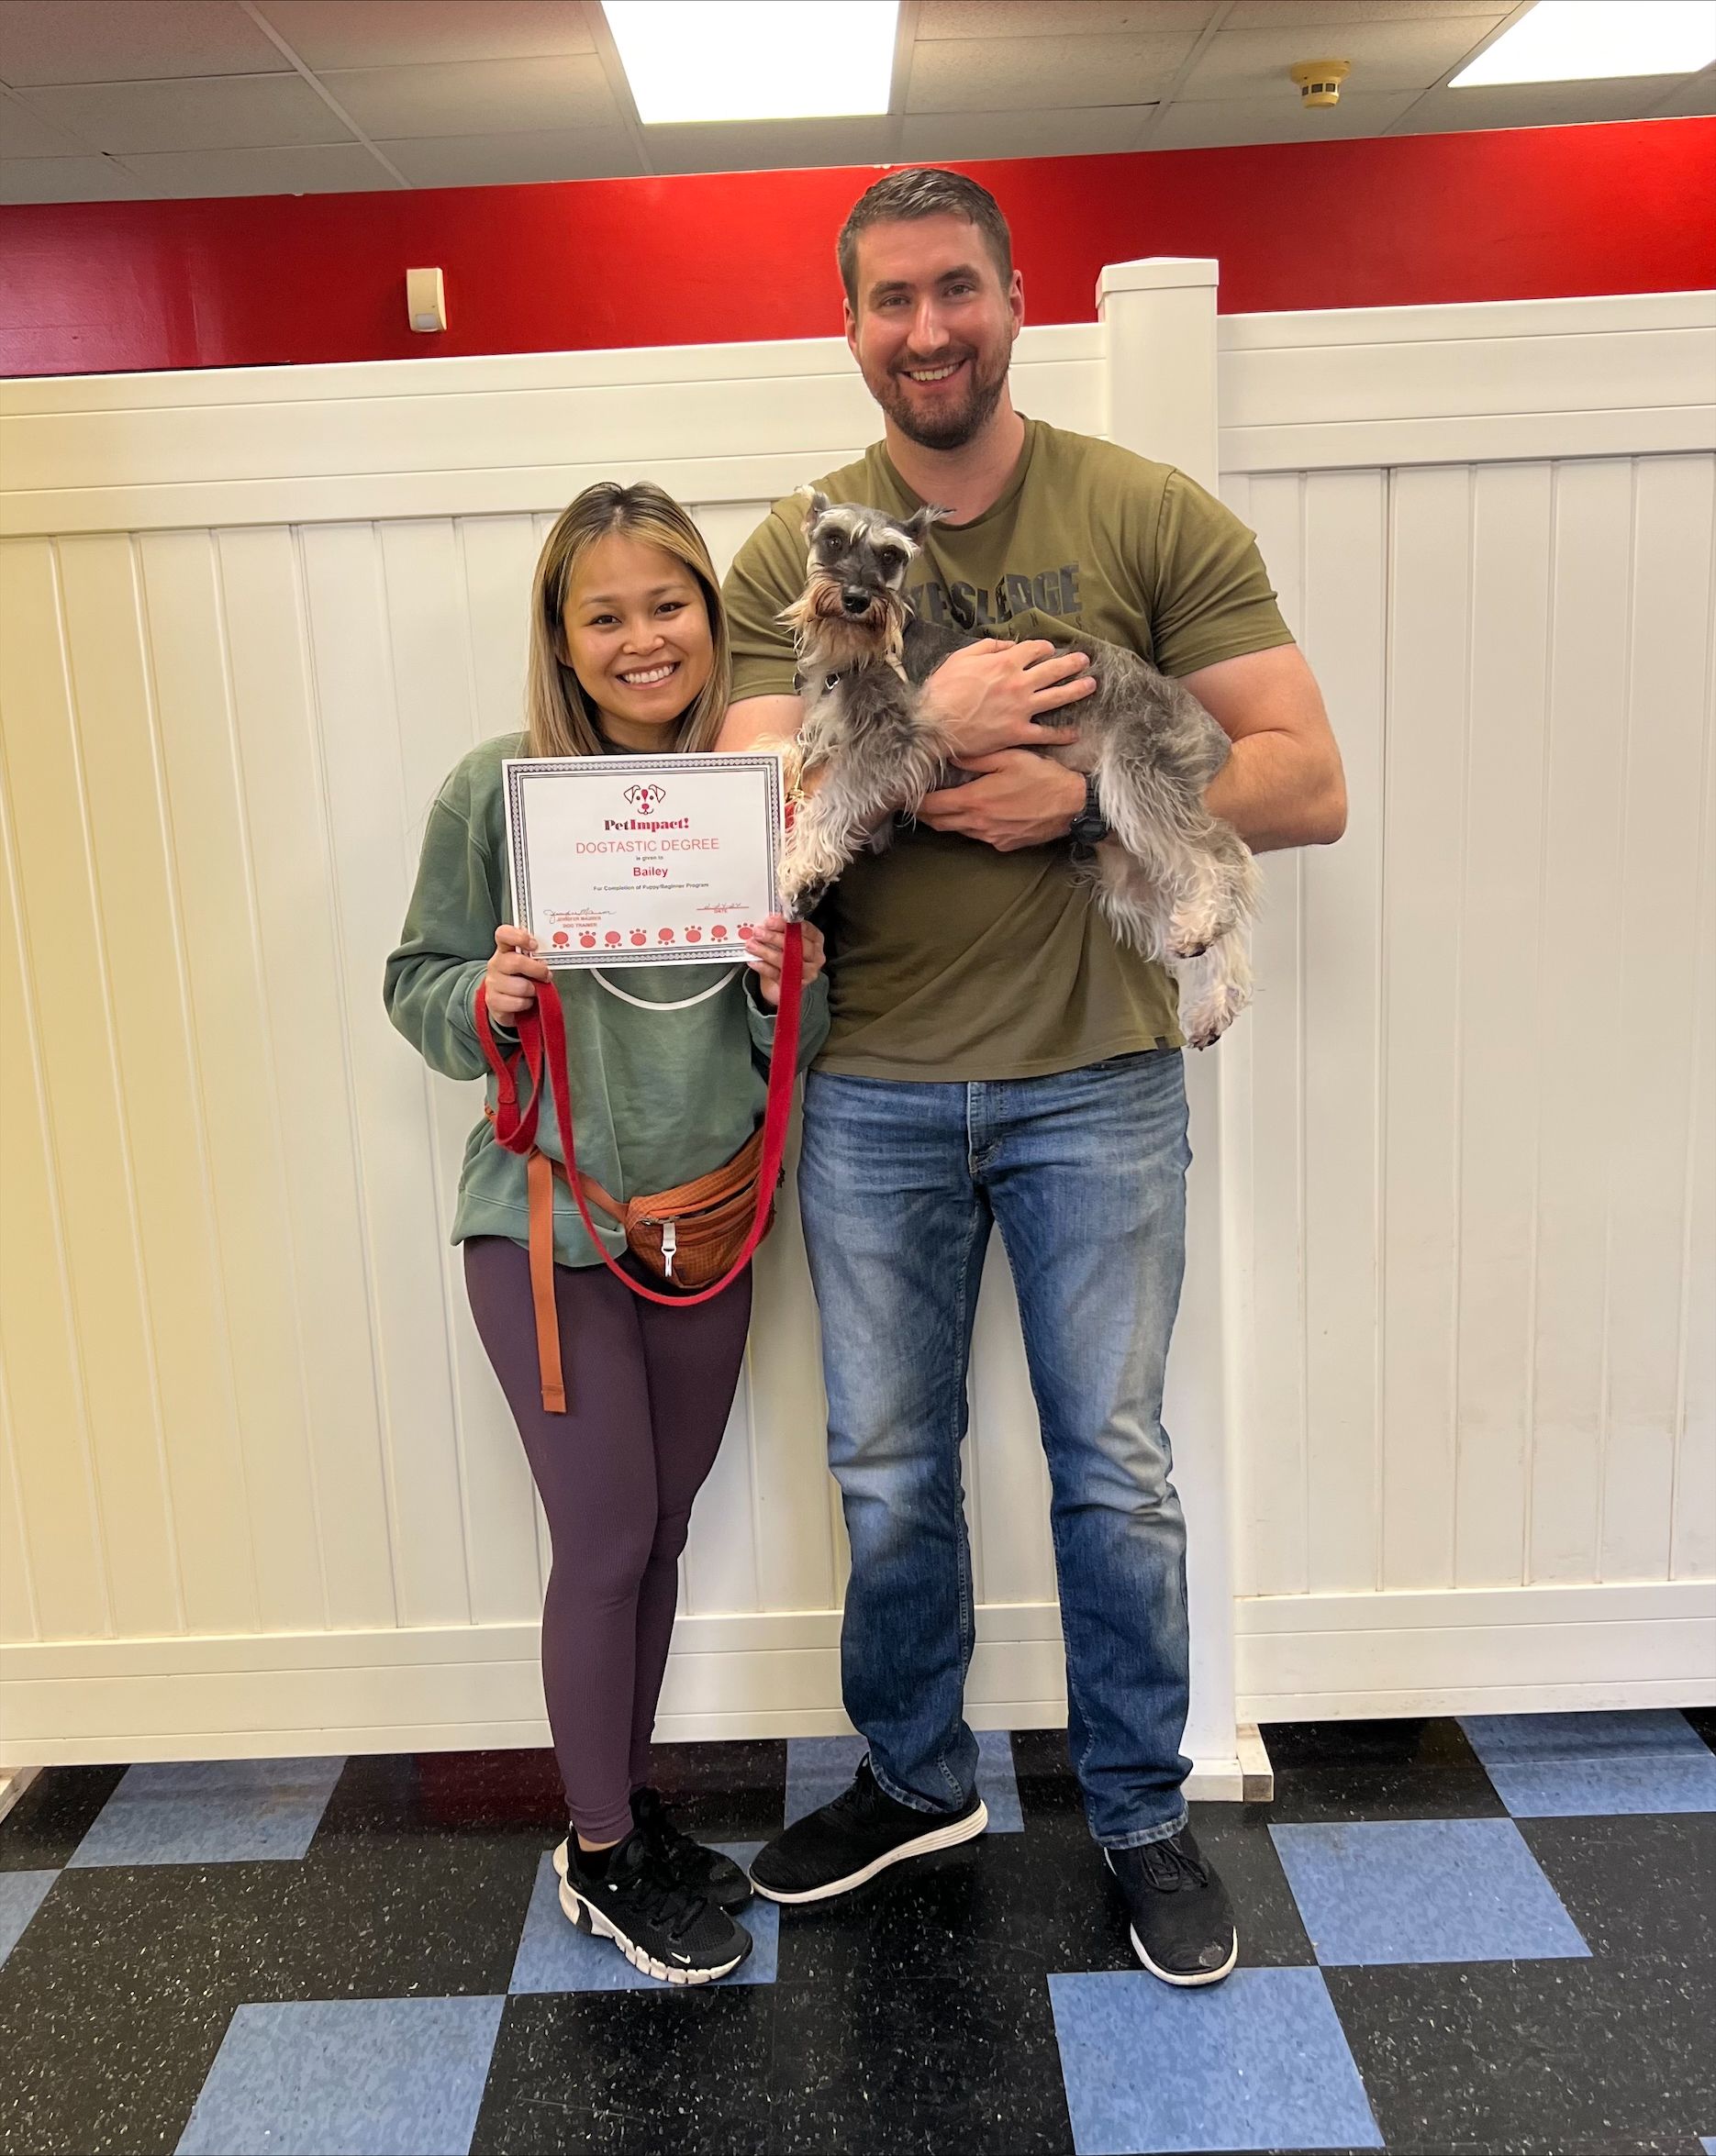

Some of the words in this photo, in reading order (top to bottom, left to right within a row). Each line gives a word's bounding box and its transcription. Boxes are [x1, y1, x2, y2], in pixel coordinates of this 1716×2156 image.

[604, 817, 689, 832] PetImpact!
[575, 839, 657, 854] DOGTASTIC
[661, 838, 719, 851] DEGREE
[633, 866, 668, 877] Bailey
